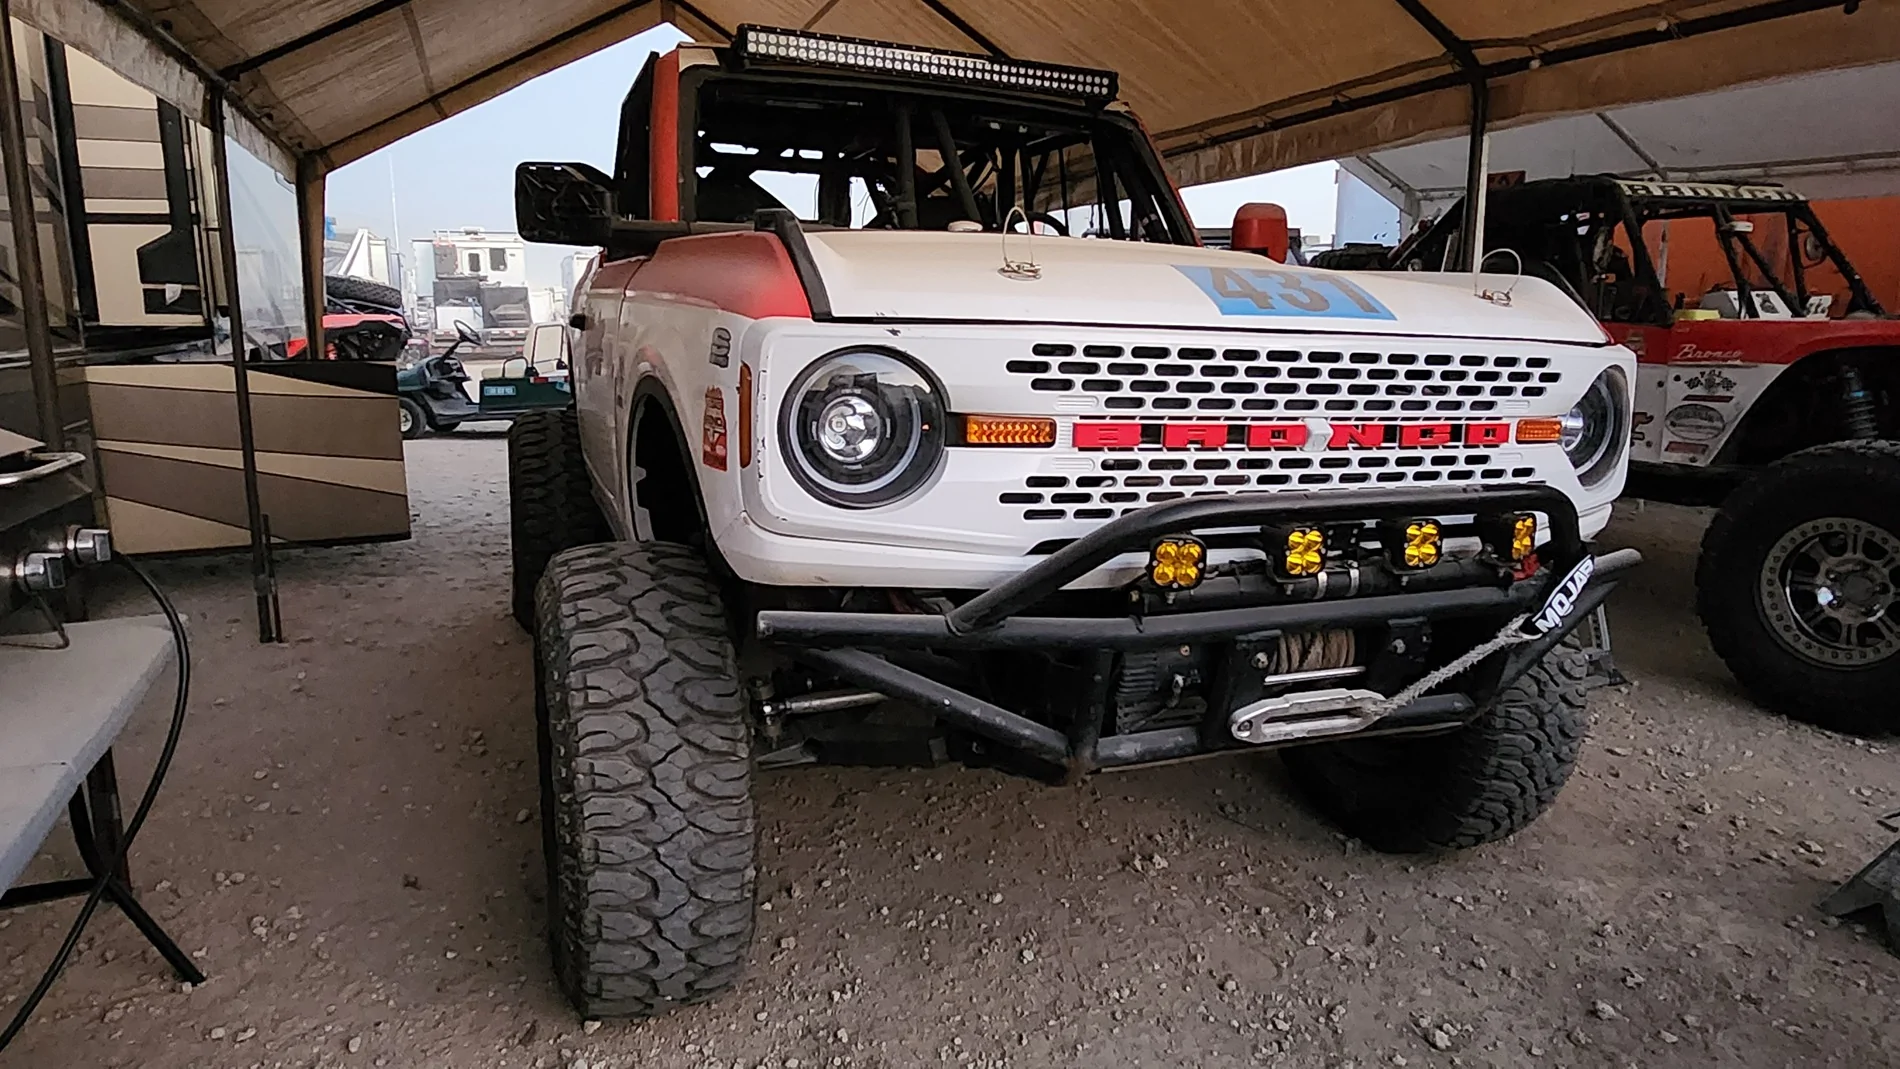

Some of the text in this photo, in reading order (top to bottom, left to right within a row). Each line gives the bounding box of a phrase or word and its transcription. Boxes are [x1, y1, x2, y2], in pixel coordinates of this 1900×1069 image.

[1209, 267, 1381, 313] 431
[1672, 343, 1743, 360] Bronco
[1072, 422, 1511, 448] BRONCO
